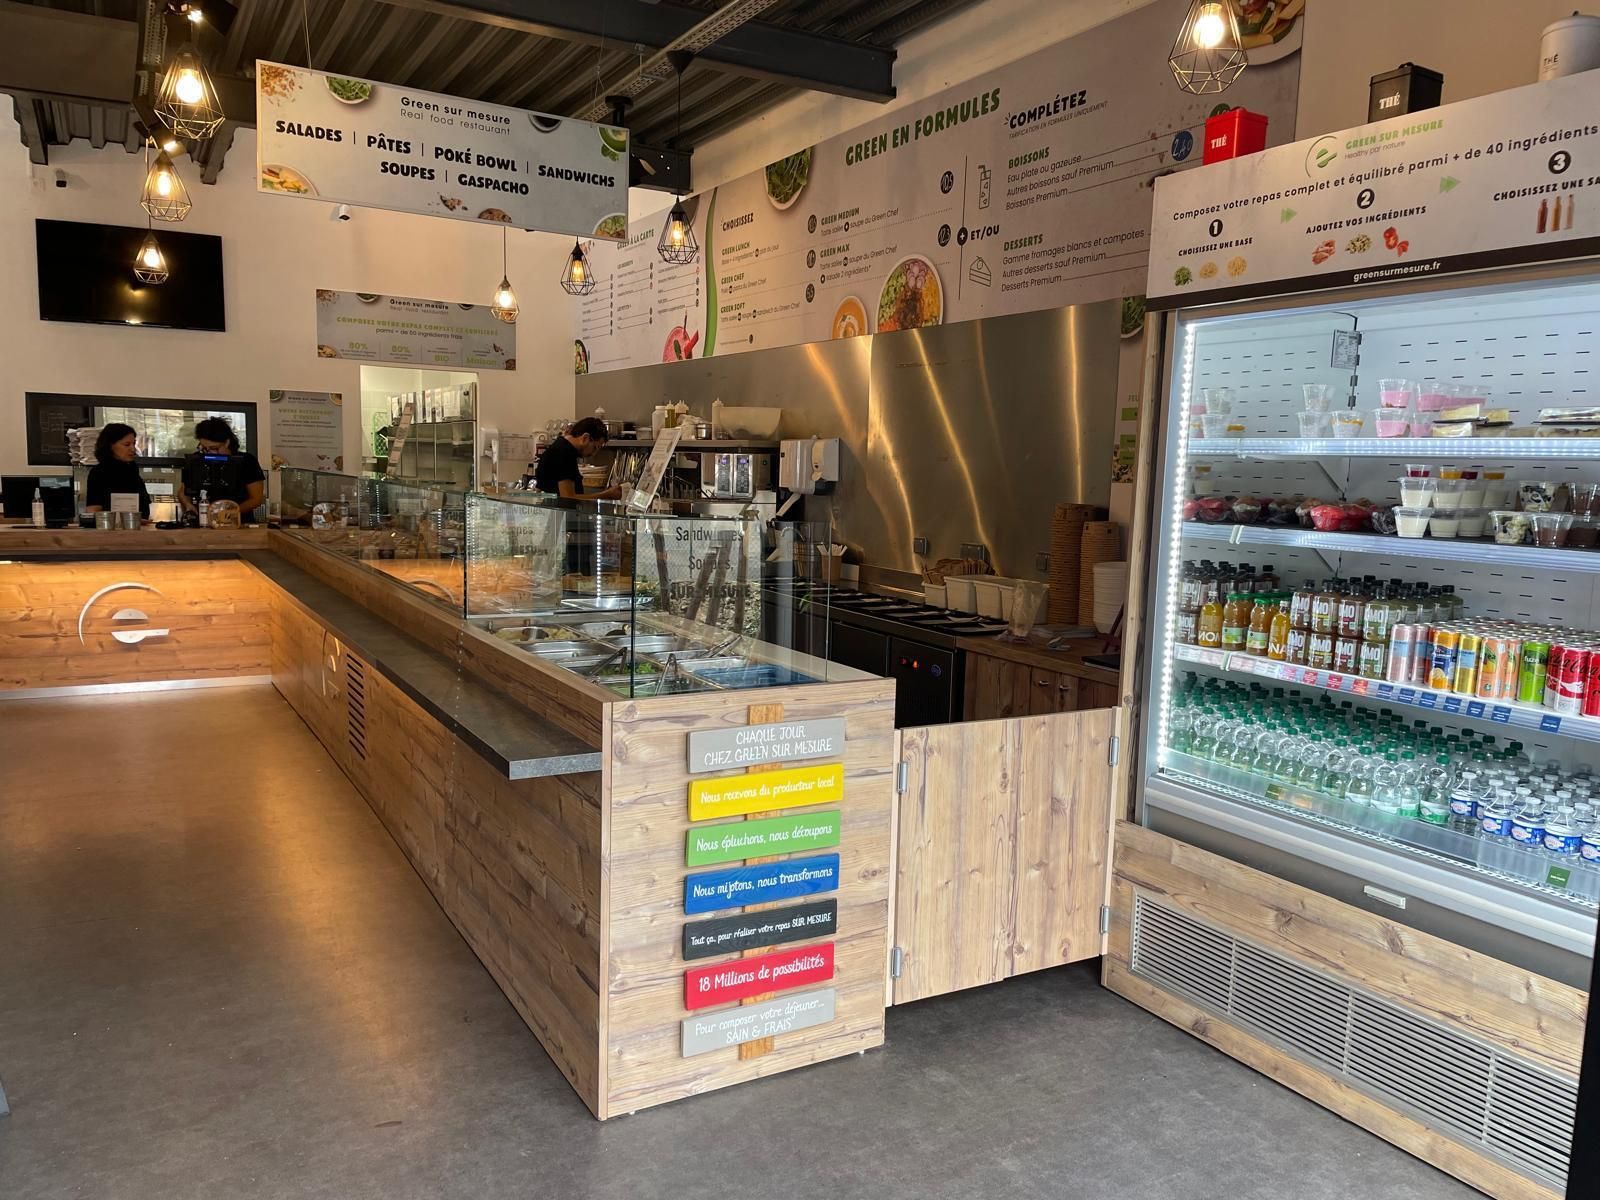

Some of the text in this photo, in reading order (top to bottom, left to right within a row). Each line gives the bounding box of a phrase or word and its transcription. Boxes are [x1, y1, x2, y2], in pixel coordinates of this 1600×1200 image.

[1544, 54, 1559, 66] THÉ
[401, 97, 511, 124] Green sur mesure
[1010, 93, 1087, 129] COMPLÉTEZ
[1379, 92, 1400, 109] THÉ
[401, 109, 510, 135] Real food restaurant
[846, 87, 1000, 166] GREEN EN FORMULES
[1345, 120, 1444, 150] GREEN SUR MESURE
[276, 120, 615, 187] SALADES PÂTES POKÉ BOWL SANDWICHS
[1211, 135, 1227, 149] THÉ
[1344, 140, 1406, 161] Healthy par nature
[1007, 155, 1082, 183] Eau plate ou gazeuse
[1008, 147, 1050, 169] BOISSONS
[1553, 154, 1565, 171] 3
[381, 161, 529, 195] SOUPES GASPACHO
[1007, 160, 1114, 197] Autres boissons sauf Premium
[1173, 205, 1221, 221] Composez
[1223, 198, 1249, 211] votre
[1252, 191, 1281, 205] repas
[1284, 180, 1330, 198] complet
[1334, 177, 1345, 187] et
[1349, 163, 1404, 184] équilibré
[1408, 153, 1448, 174] parmi
[1465, 149, 1481, 160] de
[1486, 142, 1504, 155] 40
[1508, 125, 1598, 151] ingrédients
[1006, 188, 1068, 211] Boissons Premium
[1360, 191, 1371, 207] 2
[1494, 183, 1558, 201] CHOISISSEZ
[1562, 179, 1584, 190] UNE
[723, 212, 754, 231] CHOISISSEZ
[821, 215, 837, 226] GREEN
[838, 208, 859, 219] MEDIUM
[1306, 205, 1427, 234] AJOUTEZ VOS INGRÉDIENTS
[971, 225, 1000, 240] ET/OU
[1004, 234, 1043, 251] DESSERTS
[820, 244, 850, 258] GREEN MAX
[1003, 230, 1145, 265] Gamme fromages blancs et compotes
[1179, 237, 1253, 257] CHOISISSEZ UNE BASE
[734, 273, 744, 281] CHEF
[1003, 252, 1106, 278] Autres desserts sauf Premium
[1353, 261, 1441, 282] greensurmesure.fr
[1001, 275, 1062, 293] Desserts Premium
[721, 305, 733, 313] GREEN
[736, 725, 806, 746] CHAQUE JOUR
[704, 738, 832, 766] CHEZ GREEN SUR MESURE
[701, 775, 835, 804] Nous recevons du producteur local
[697, 839, 718, 852] Nous
[769, 831, 789, 842] nous
[792, 824, 832, 842] découpons
[693, 884, 715, 898] Nous
[757, 878, 777, 888] nous
[779, 868, 833, 884] transformons
[691, 937, 705, 946] Tout
[718, 933, 732, 944] pour
[733, 927, 757, 939] réaliser
[758, 924, 773, 934] votre
[775, 922, 790, 934] repas
[792, 917, 806, 928] SUR
[807, 912, 832, 924] MESURE
[699, 954, 825, 992] 18 Millions de possibilités
[695, 1023, 716, 1036] Pour
[719, 1015, 756, 1032] composer
[760, 1008, 782, 1019] votre
[726, 1018, 792, 1044] SAIN & FRAIS
